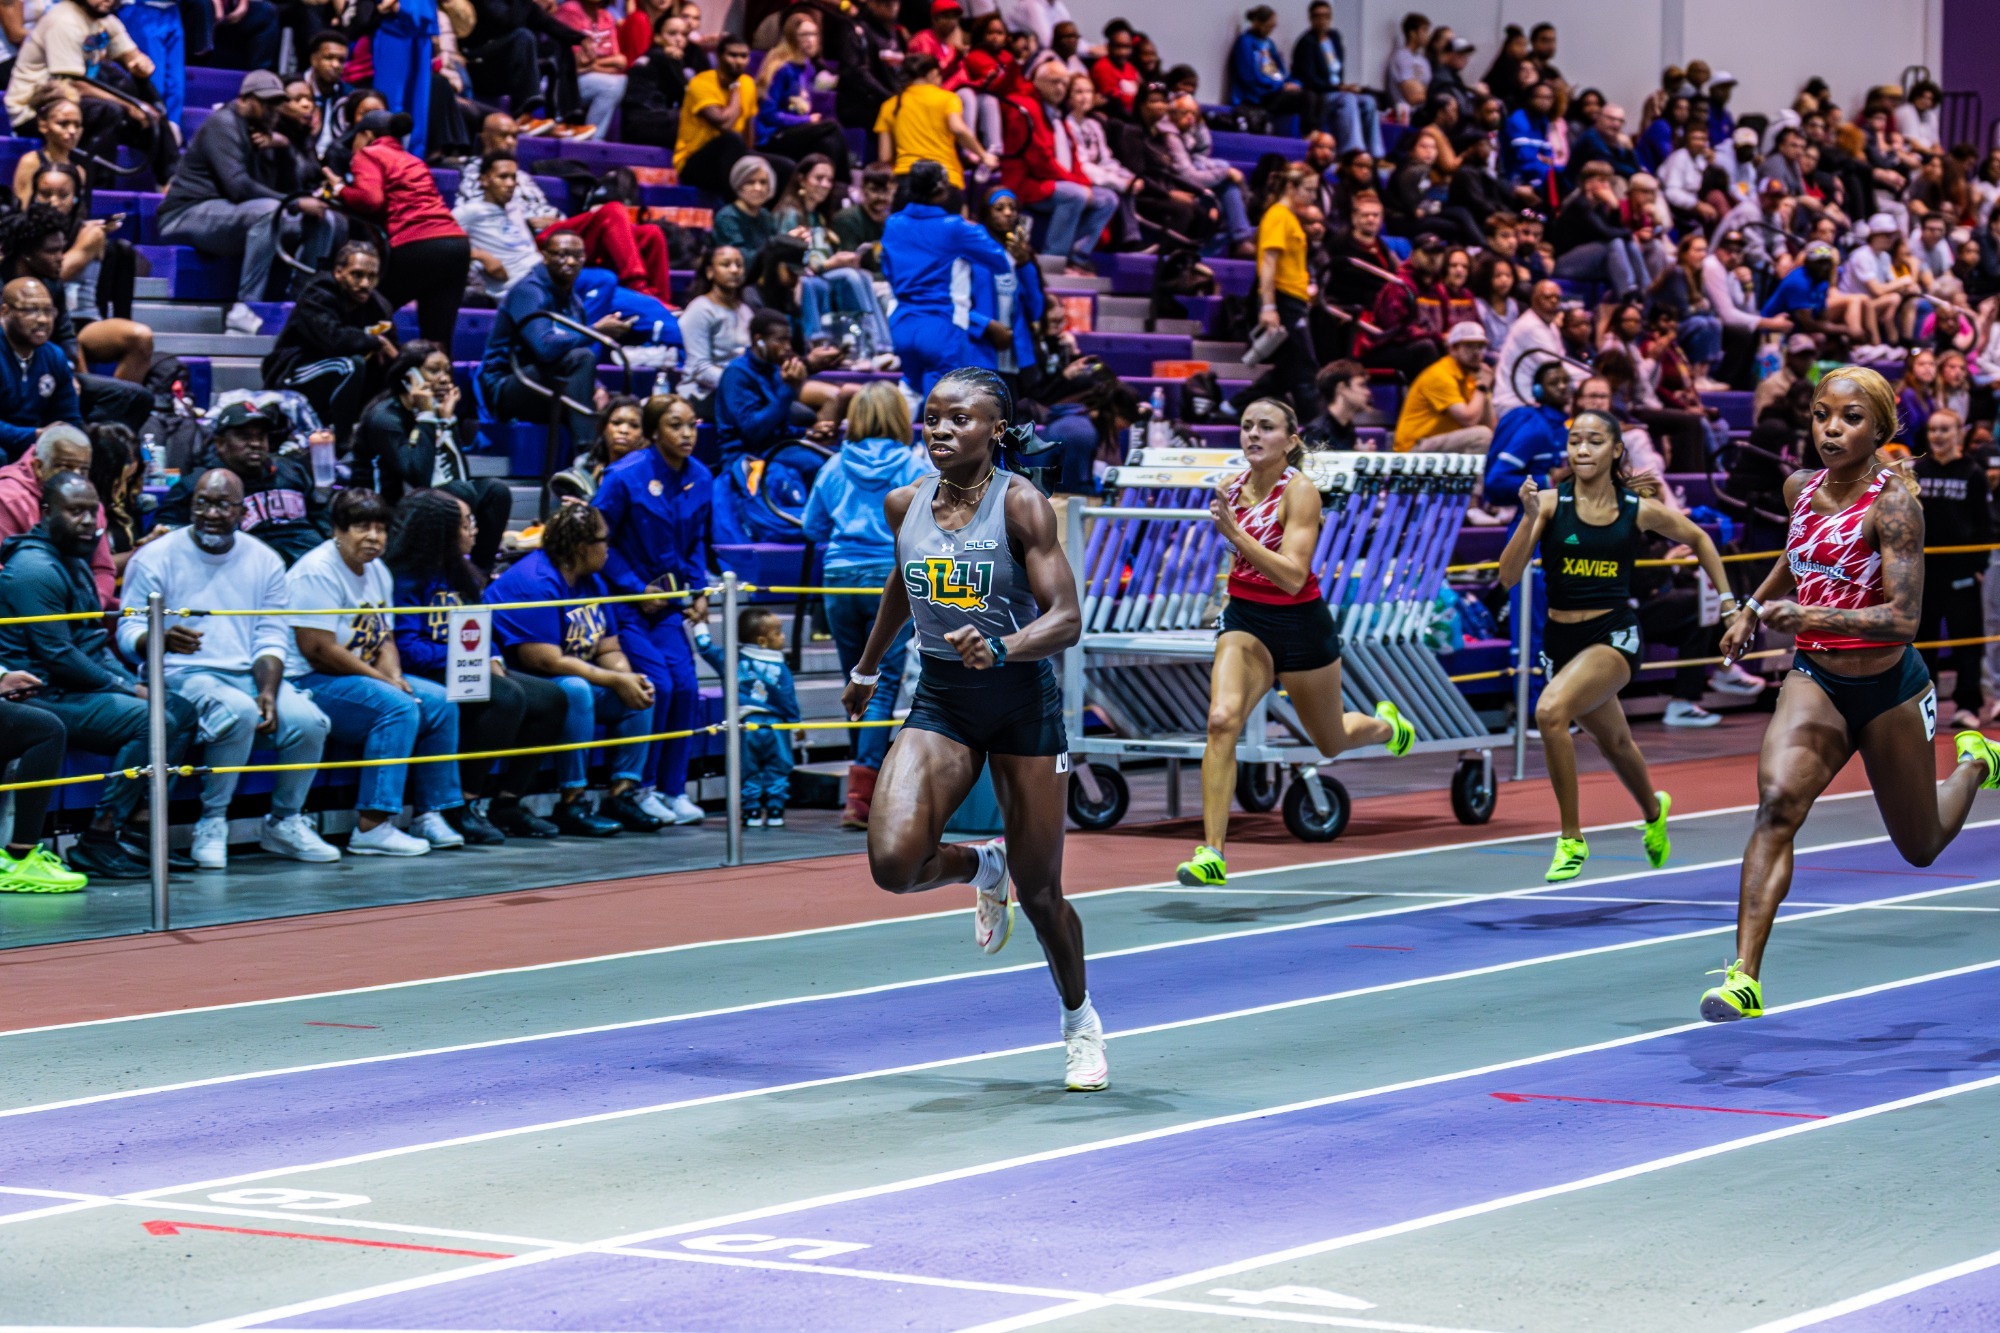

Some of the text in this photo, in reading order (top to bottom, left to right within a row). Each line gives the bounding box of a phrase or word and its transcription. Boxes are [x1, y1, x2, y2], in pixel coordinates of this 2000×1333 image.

[1562, 557, 1619, 577] XAVIER
[1787, 549, 1851, 580] Louisiana
[905, 558, 994, 602] SLU
[462, 629, 480, 641] STOP
[457, 658, 483, 667] DO NOT
[458, 675, 480, 683] CROSS
[1924, 694, 1936, 736] 5
[679, 1233, 872, 1259] 5
[1206, 1285, 1378, 1311] 4
